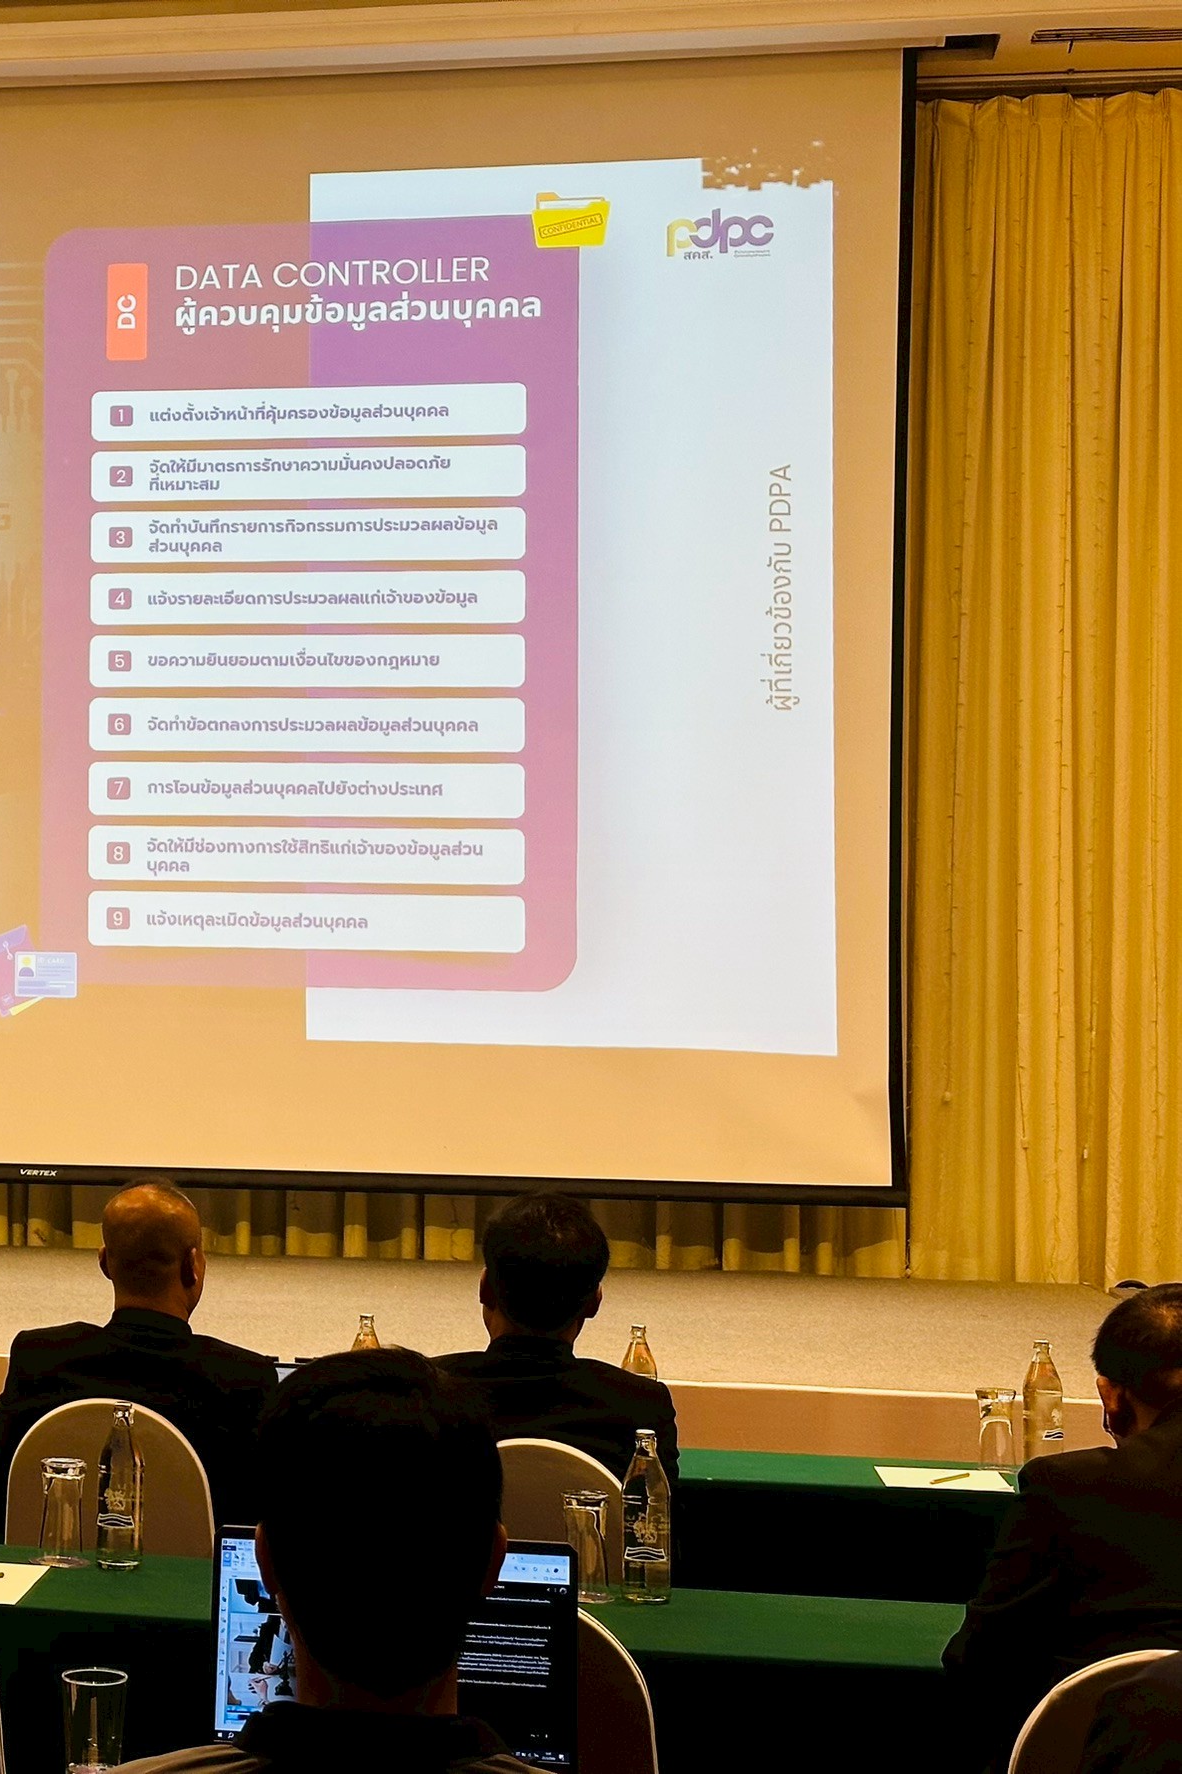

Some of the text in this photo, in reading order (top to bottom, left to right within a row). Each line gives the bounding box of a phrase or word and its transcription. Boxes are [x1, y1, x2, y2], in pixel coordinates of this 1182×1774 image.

[542, 215, 600, 236] CONFIDENTIAL
[175, 256, 491, 291] DATA CONTROLLER
[117, 294, 137, 329] DC
[175, 291, 542, 335] ผู้ควบคุมข้อมูลส่วนบุคคล
[117, 401, 450, 424] 1 แต่งตั้งเจ้าหน้าที่คุ้มครองข้อมูลส่วนบุคคล
[116, 452, 451, 483] 2 จัดให้มีมาตรการรักษาความมั่นคงปลอดภัย
[149, 473, 220, 491] ที่เหมาะสม
[116, 516, 498, 545] 3 จัดทำบันทึกรายการกิจกรรมการประมวลผลข้อมูล
[148, 538, 223, 557] ส่วนบุคคล
[114, 588, 478, 609] 4 แจ้งรายละเอียดการประมวลผลแก่เจ้าของข้อมูล
[760, 464, 800, 711] ผู้ที่เกี่ยวข้องกับ PDPA
[114, 647, 440, 671] 5 ขอความยินยอมตามเงื่อนไขของกฎหมาย
[114, 714, 479, 737] 6 จัดทำข้อตกลงการประมวลผลข้อมูลส่วนบุคคล
[114, 778, 443, 800] 7 การโอนข้อมูลส่วนบุคคลไปยังต่างประเทศ
[113, 837, 484, 861] 8 จัดให้มีช่องทางการใช้สิทธิแก่เจ้าของข้อมูลส่วน
[146, 859, 190, 875] บุคคล
[113, 910, 369, 933] 9 แจ้งเหตุละเมิดข้อมูลส่วนบุคคล
[20, 1168, 58, 1177] VERTEX
